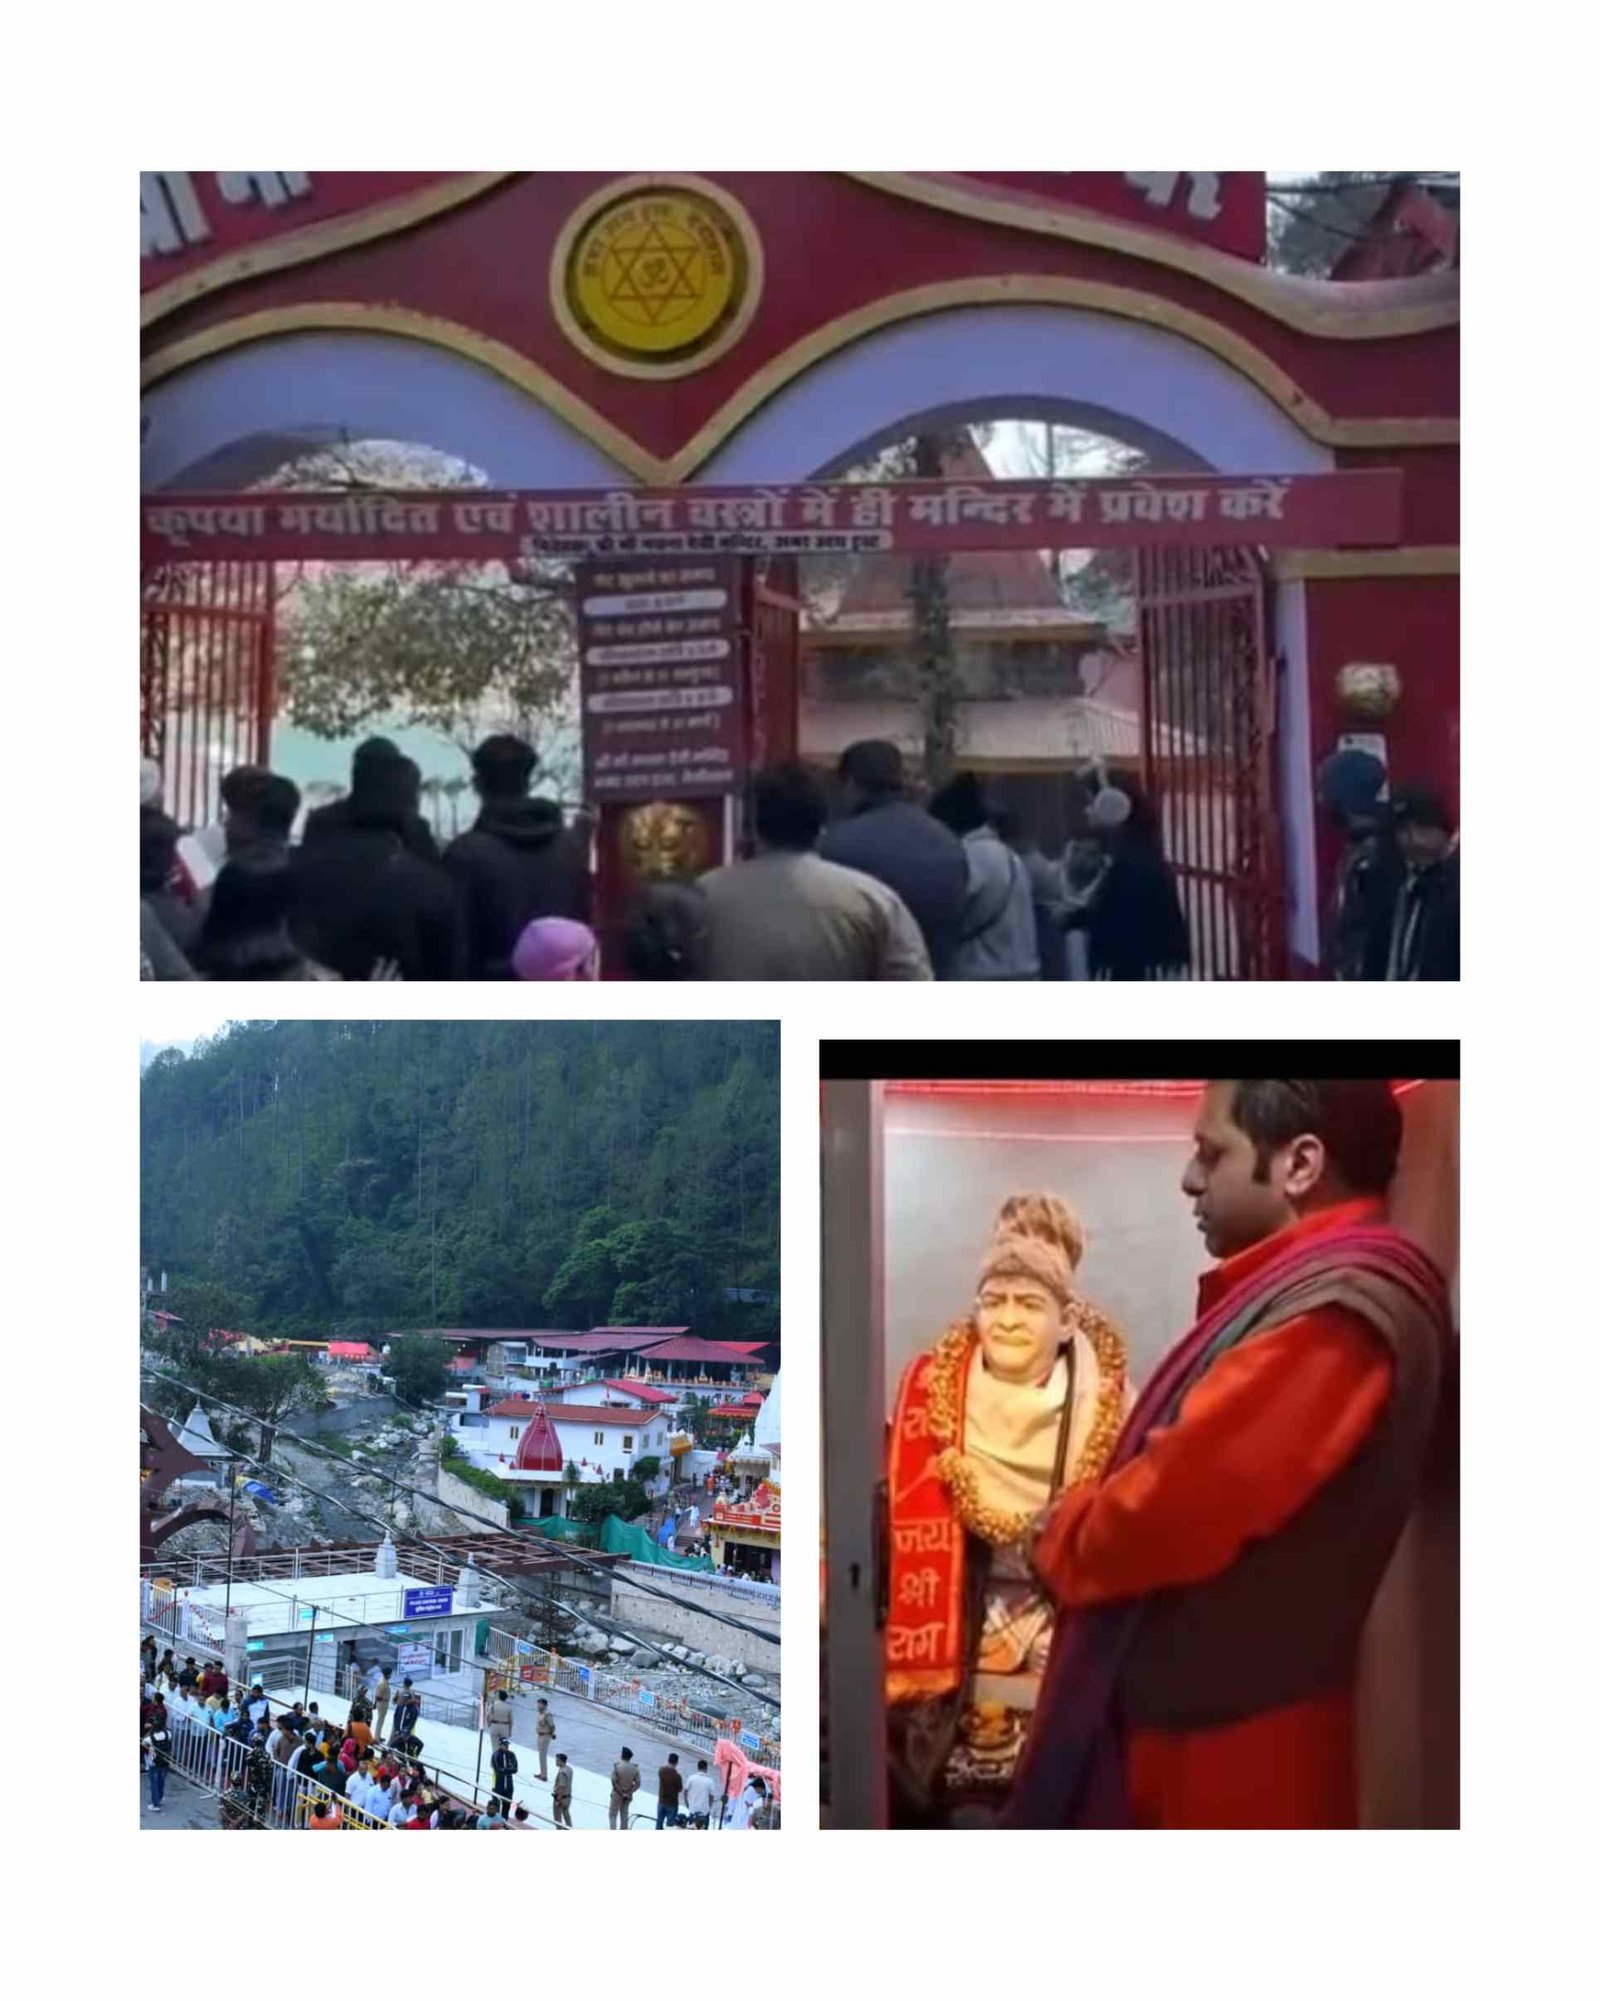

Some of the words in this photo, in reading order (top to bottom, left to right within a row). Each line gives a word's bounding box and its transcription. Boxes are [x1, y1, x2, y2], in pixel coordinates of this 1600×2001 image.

[145, 504, 267, 547] कृपया
[452, 491, 518, 533] एवं
[527, 491, 676, 532] शालीन
[688, 488, 789, 528] वस्त्रों
[802, 487, 841, 527] में
[852, 486, 898, 527] ही
[907, 485, 1037, 526] मन्दिर
[1047, 481, 1090, 523] में
[1099, 481, 1211, 523] प्रवेश
[1218, 478, 1292, 520] करें
[893, 1517, 951, 1552] जय
[898, 1566, 941, 1608] श्री
[886, 1621, 946, 1662] राम
